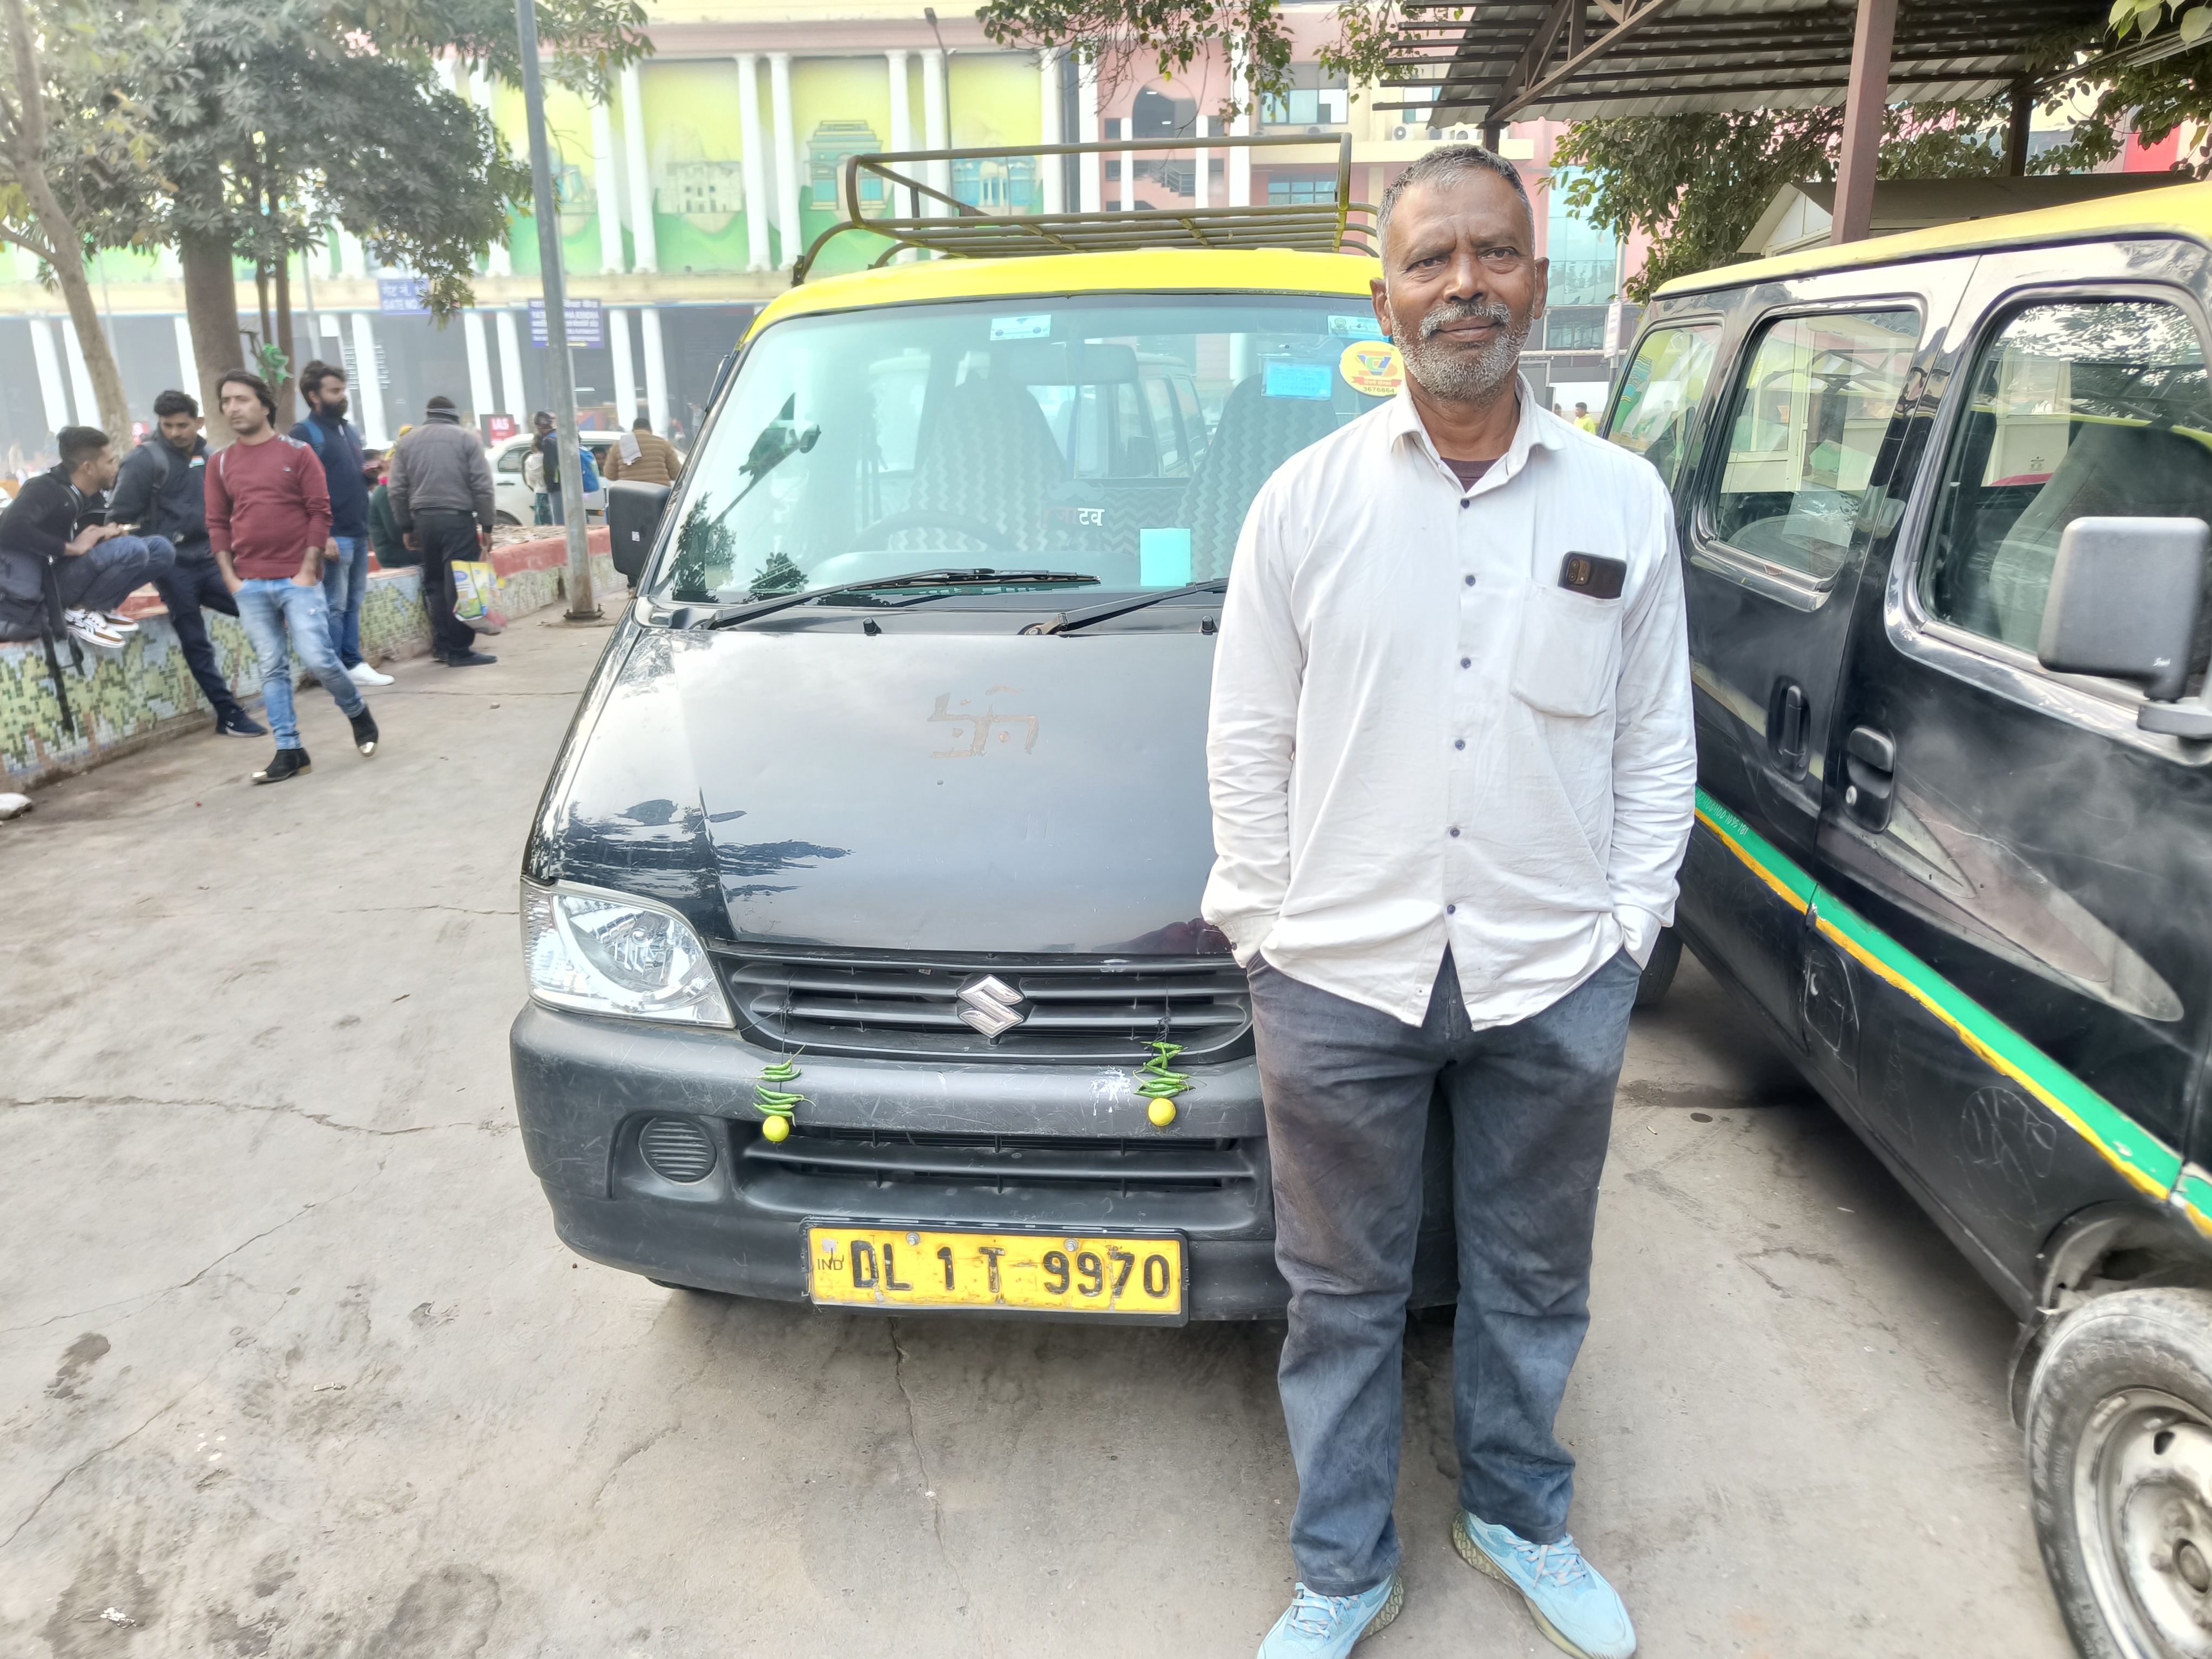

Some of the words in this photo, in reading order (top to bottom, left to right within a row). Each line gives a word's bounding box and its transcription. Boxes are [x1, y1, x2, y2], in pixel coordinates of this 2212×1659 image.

[817, 1257, 844, 1271] IND
[851, 1240, 913, 1291] DL
[937, 1246, 955, 1291] 1
[979, 1246, 1005, 1293] T
[1043, 1250, 1171, 1298] 9970
